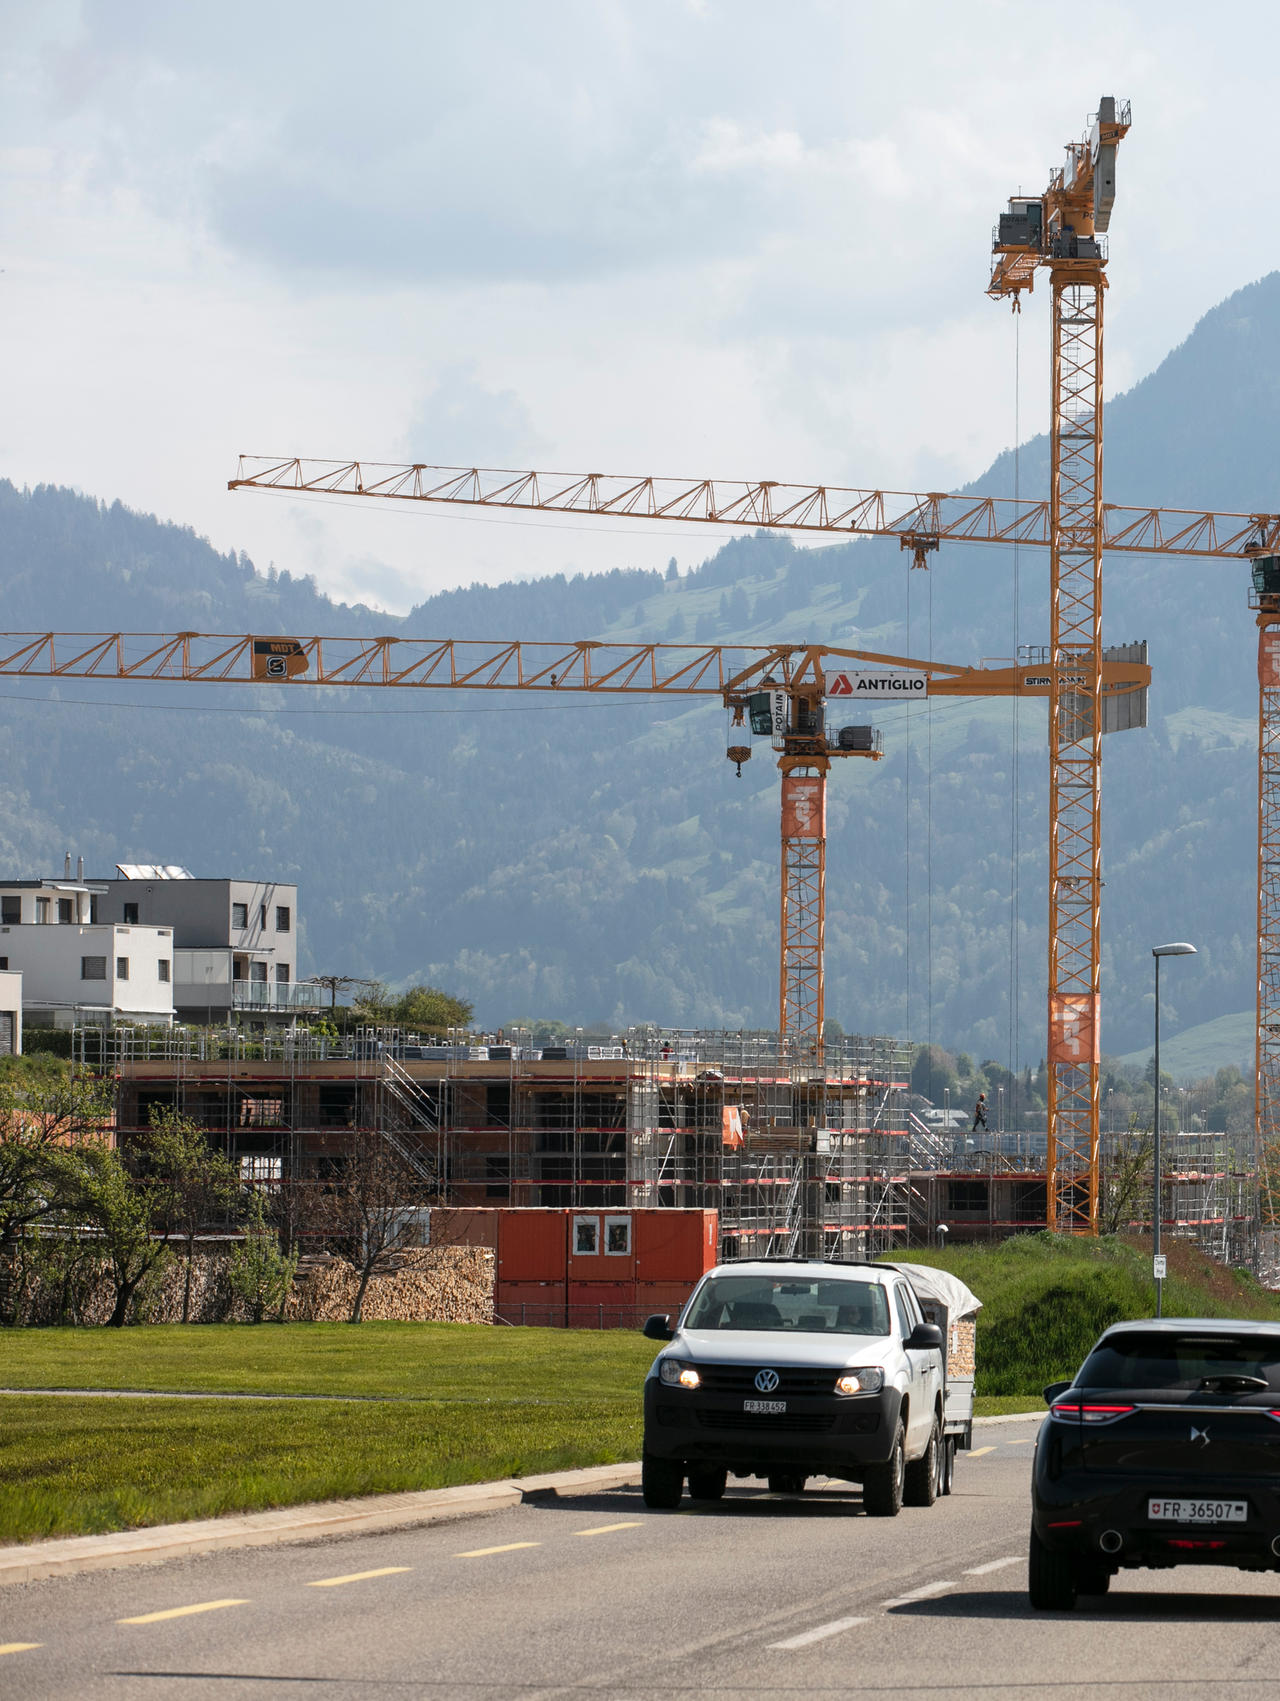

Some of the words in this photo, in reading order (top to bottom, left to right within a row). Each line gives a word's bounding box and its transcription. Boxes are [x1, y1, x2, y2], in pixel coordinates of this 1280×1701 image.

[270, 643, 295, 653] MDT
[857, 679, 924, 690] ANTIGLIO
[1026, 676, 1085, 685] STIRNANN
[775, 694, 784, 731] POTAIN
